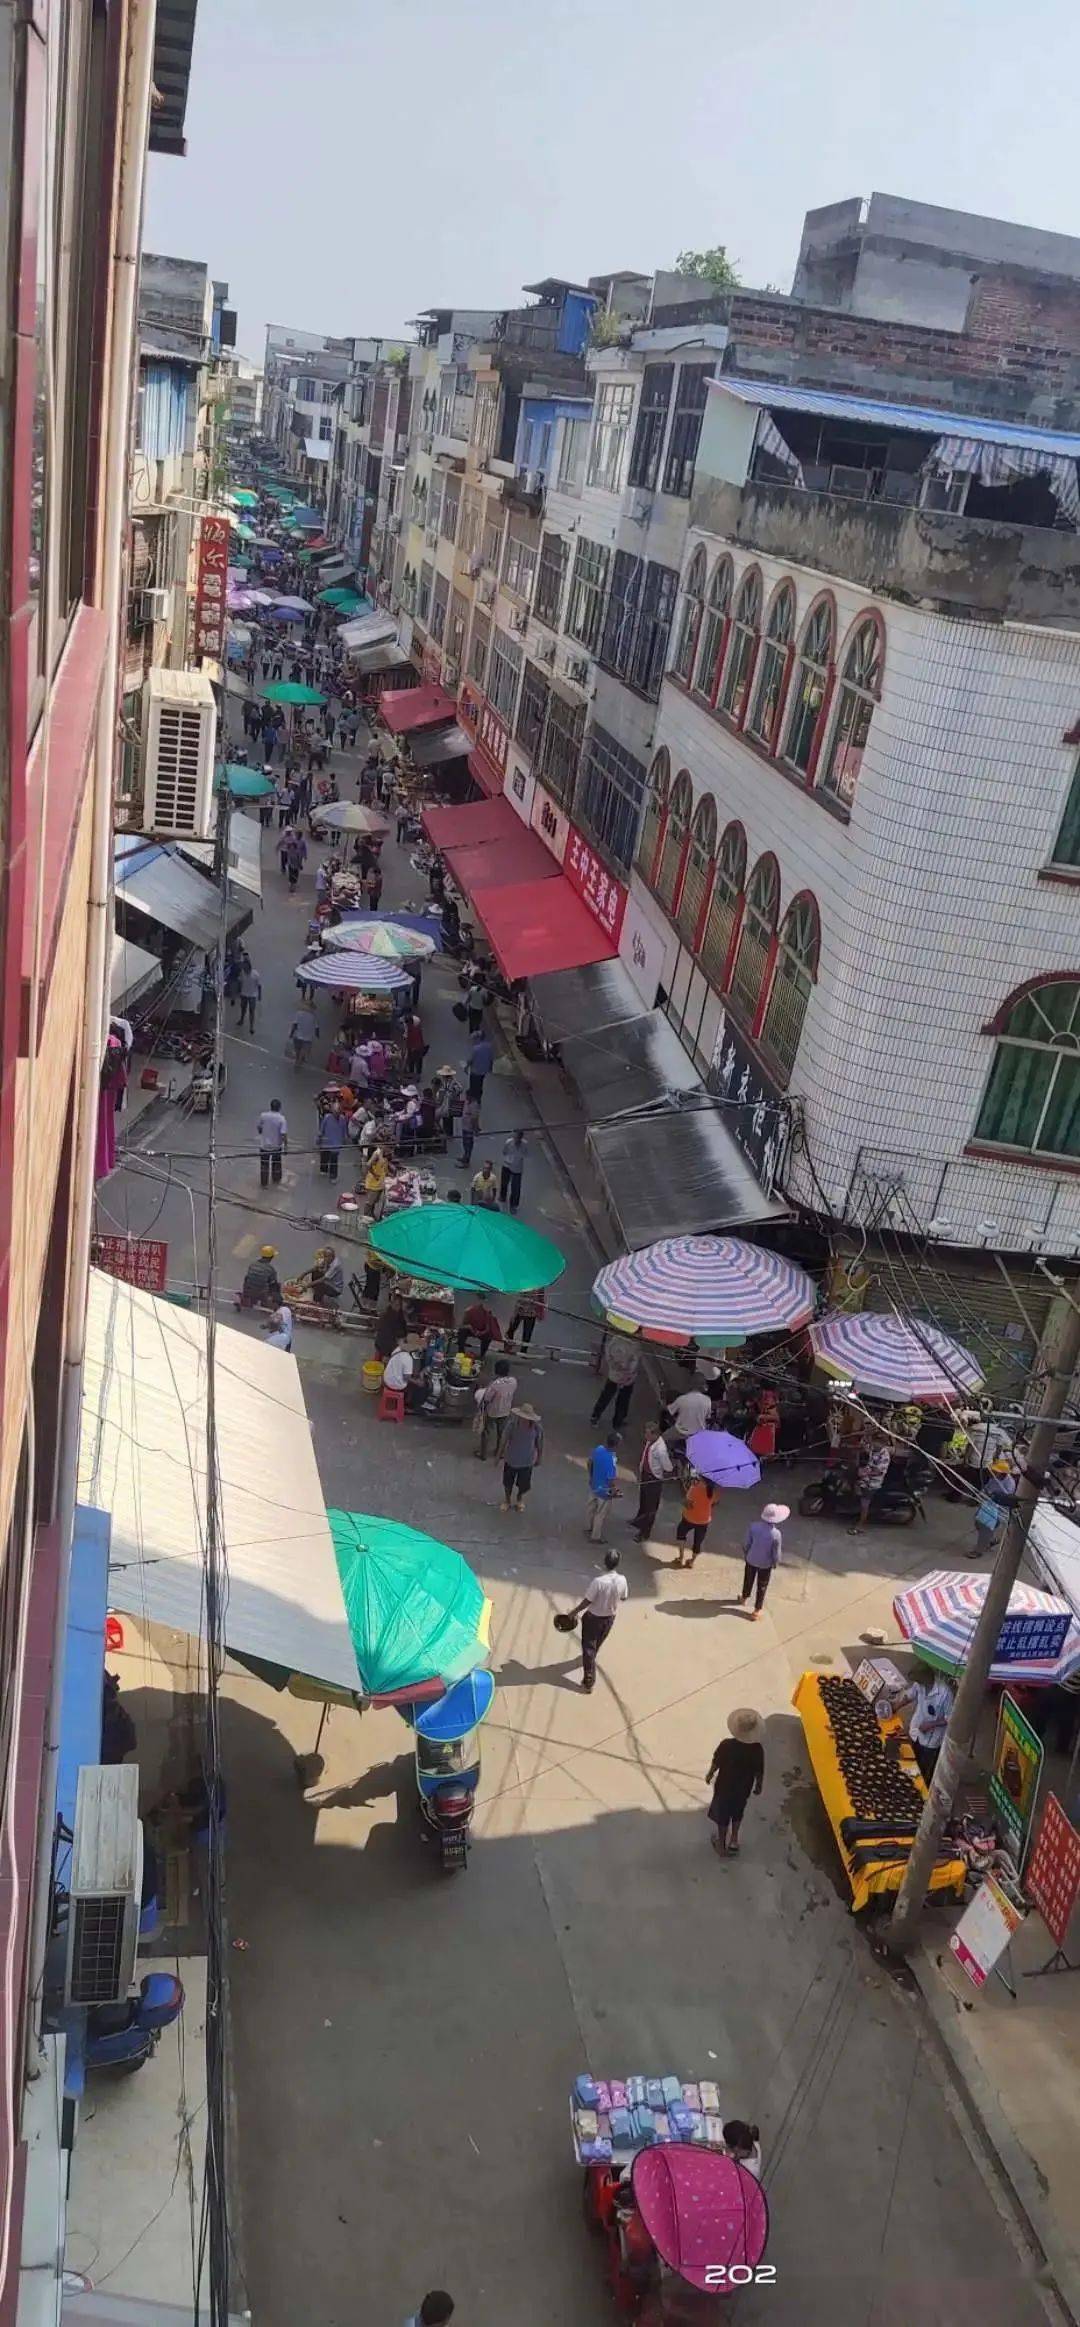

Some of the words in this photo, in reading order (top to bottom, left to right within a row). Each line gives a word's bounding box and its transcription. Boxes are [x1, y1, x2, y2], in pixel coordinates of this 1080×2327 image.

[569, 835, 618, 926] 王中王家电
